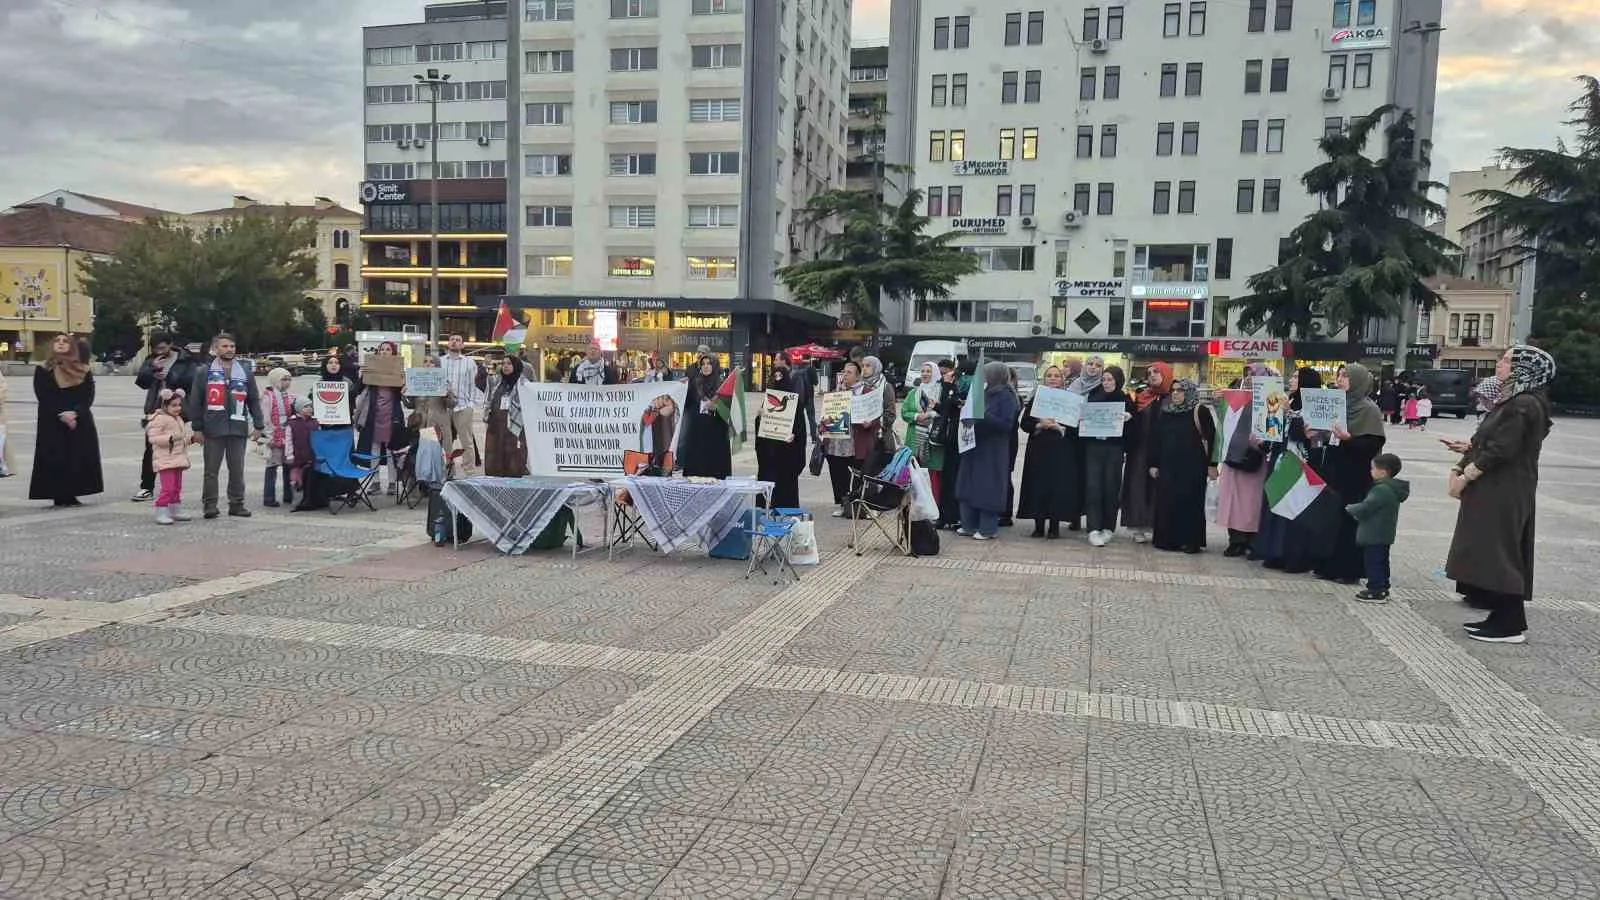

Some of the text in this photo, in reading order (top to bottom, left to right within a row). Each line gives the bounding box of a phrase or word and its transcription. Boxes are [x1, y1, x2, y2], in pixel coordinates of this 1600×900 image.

[378, 192, 405, 200] Center
[1074, 280, 1122, 288] MEYDAN
[1080, 287, 1116, 296] OPTİK
[994, 340, 1016, 348] BBVA
[1224, 340, 1279, 352] ECZANE
[1366, 346, 1395, 355] RENK
